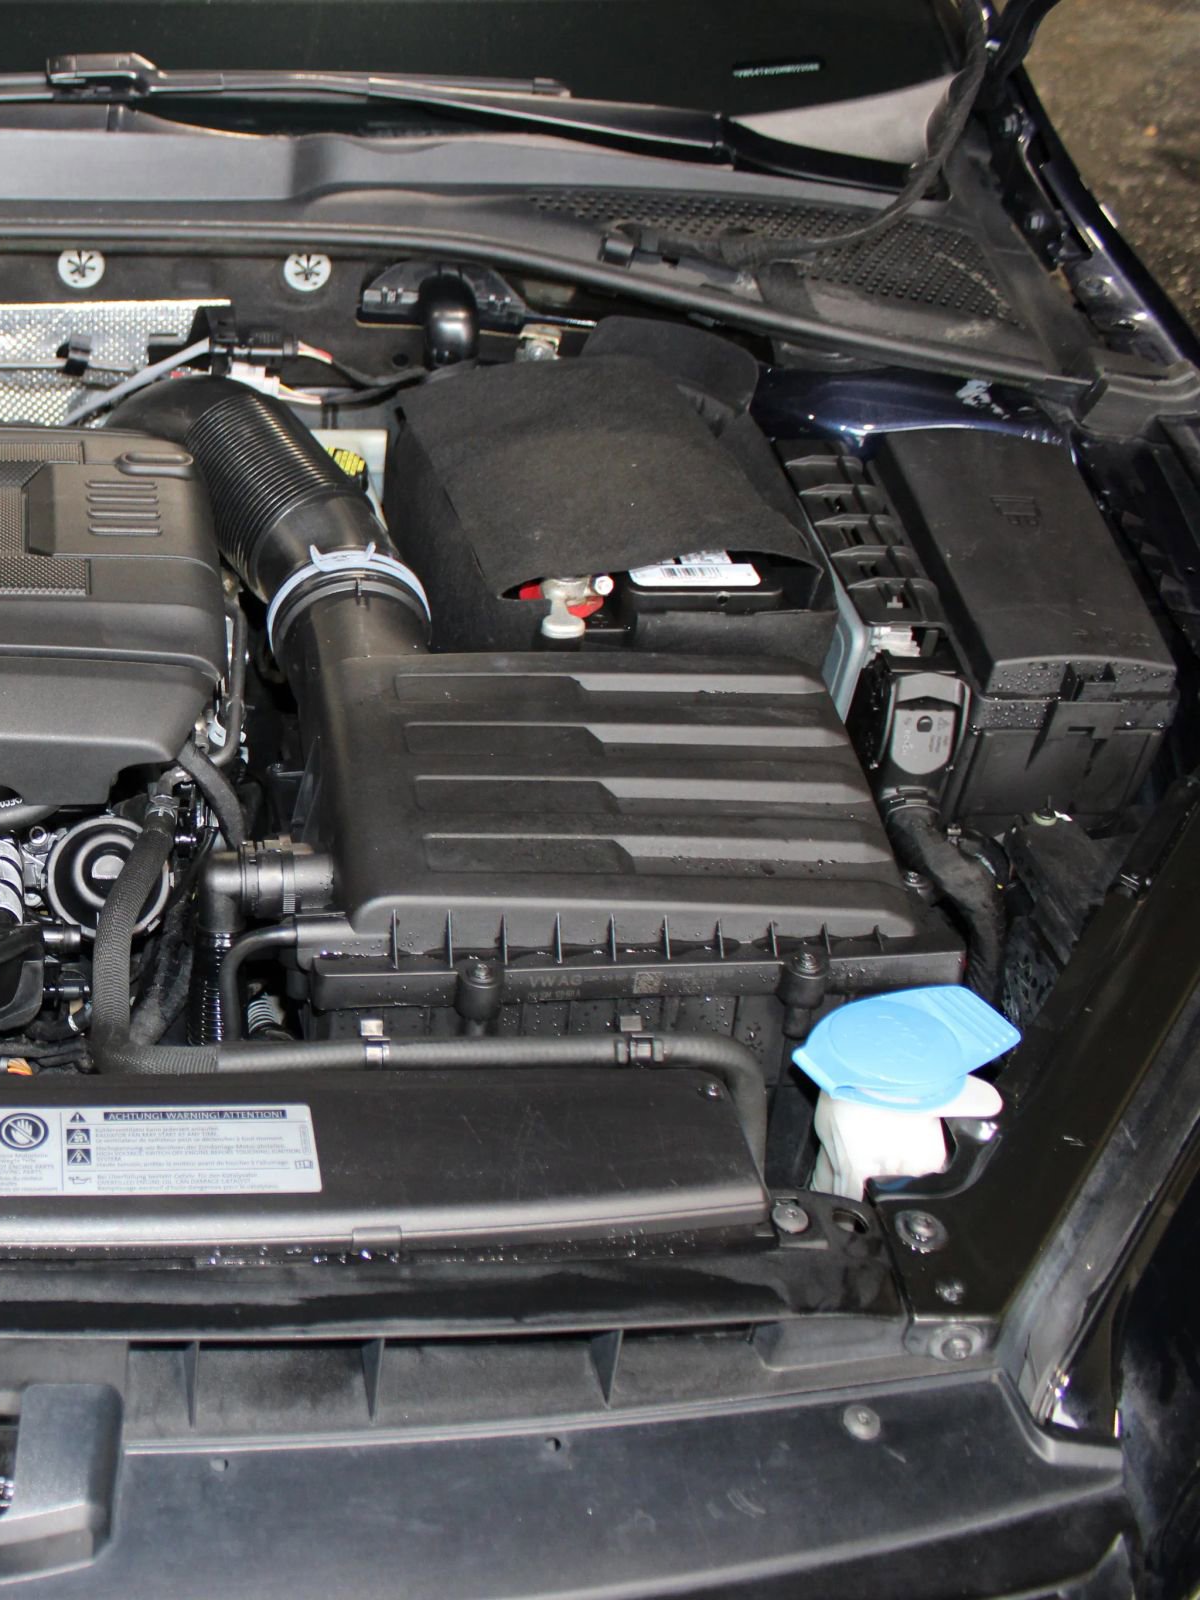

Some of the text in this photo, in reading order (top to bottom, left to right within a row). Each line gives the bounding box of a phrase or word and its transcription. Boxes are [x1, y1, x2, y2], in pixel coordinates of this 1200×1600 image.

[528, 975, 557, 987] VW
[558, 974, 582, 986] AG
[108, 1110, 284, 1121] ACHTUNG! WARNING! ATTENTION!
